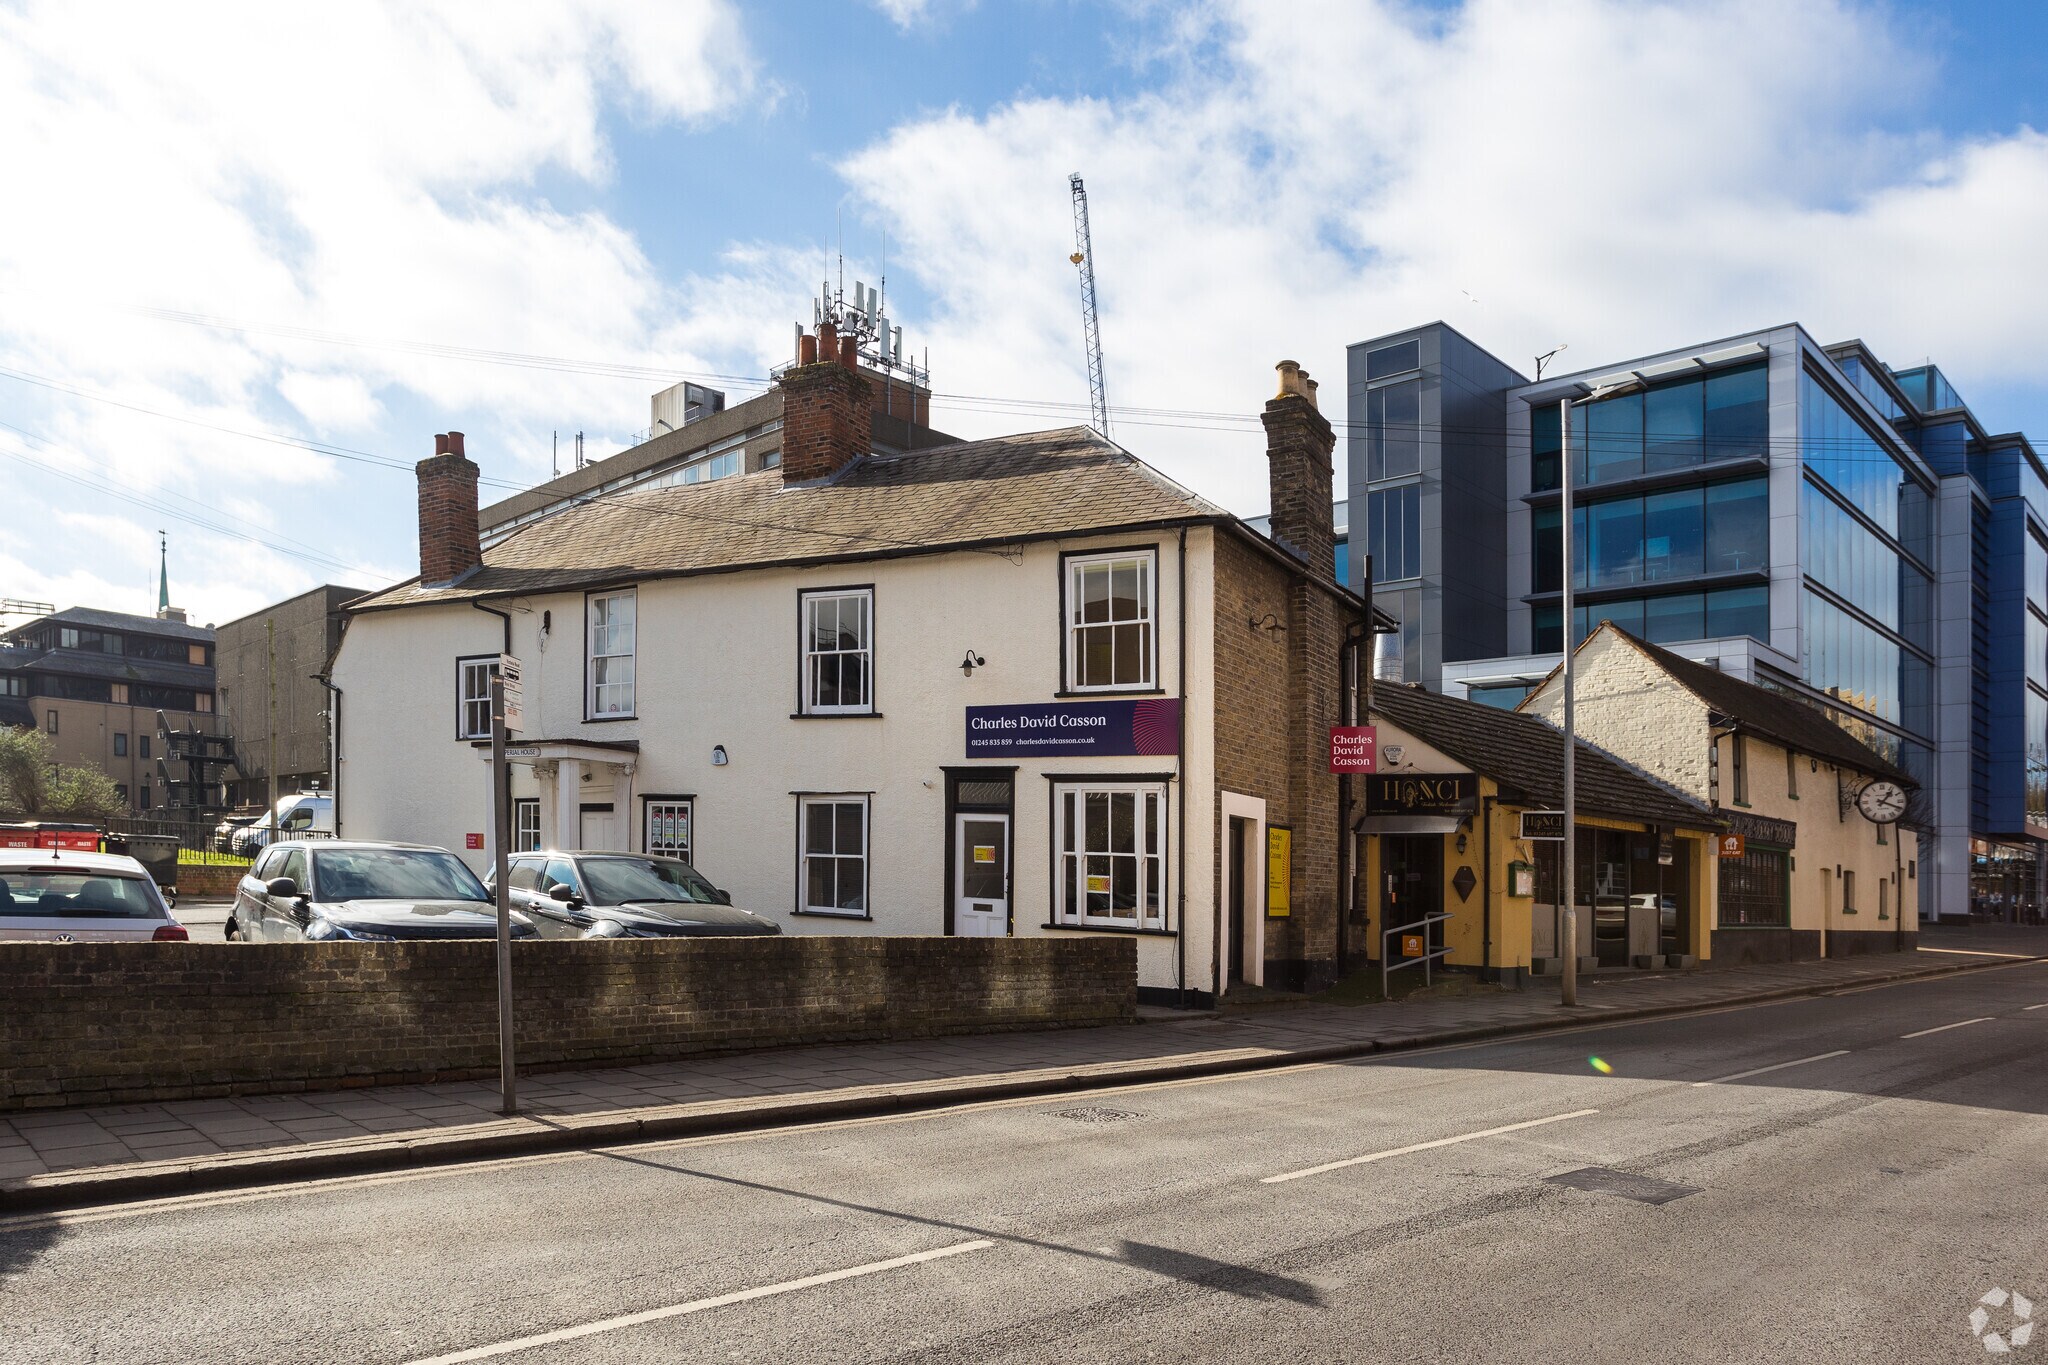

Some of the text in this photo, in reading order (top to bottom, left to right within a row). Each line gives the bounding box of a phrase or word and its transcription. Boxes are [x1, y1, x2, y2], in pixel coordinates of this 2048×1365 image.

[971, 714, 1107, 730] Charles David Casson
[1001, 738, 1013, 746] 859
[1015, 736, 1095, 746] charlesdavidcasson.co.uk
[1333, 734, 1373, 744] Charles
[1333, 745, 1364, 755] David
[1333, 756, 1370, 766] Casson
